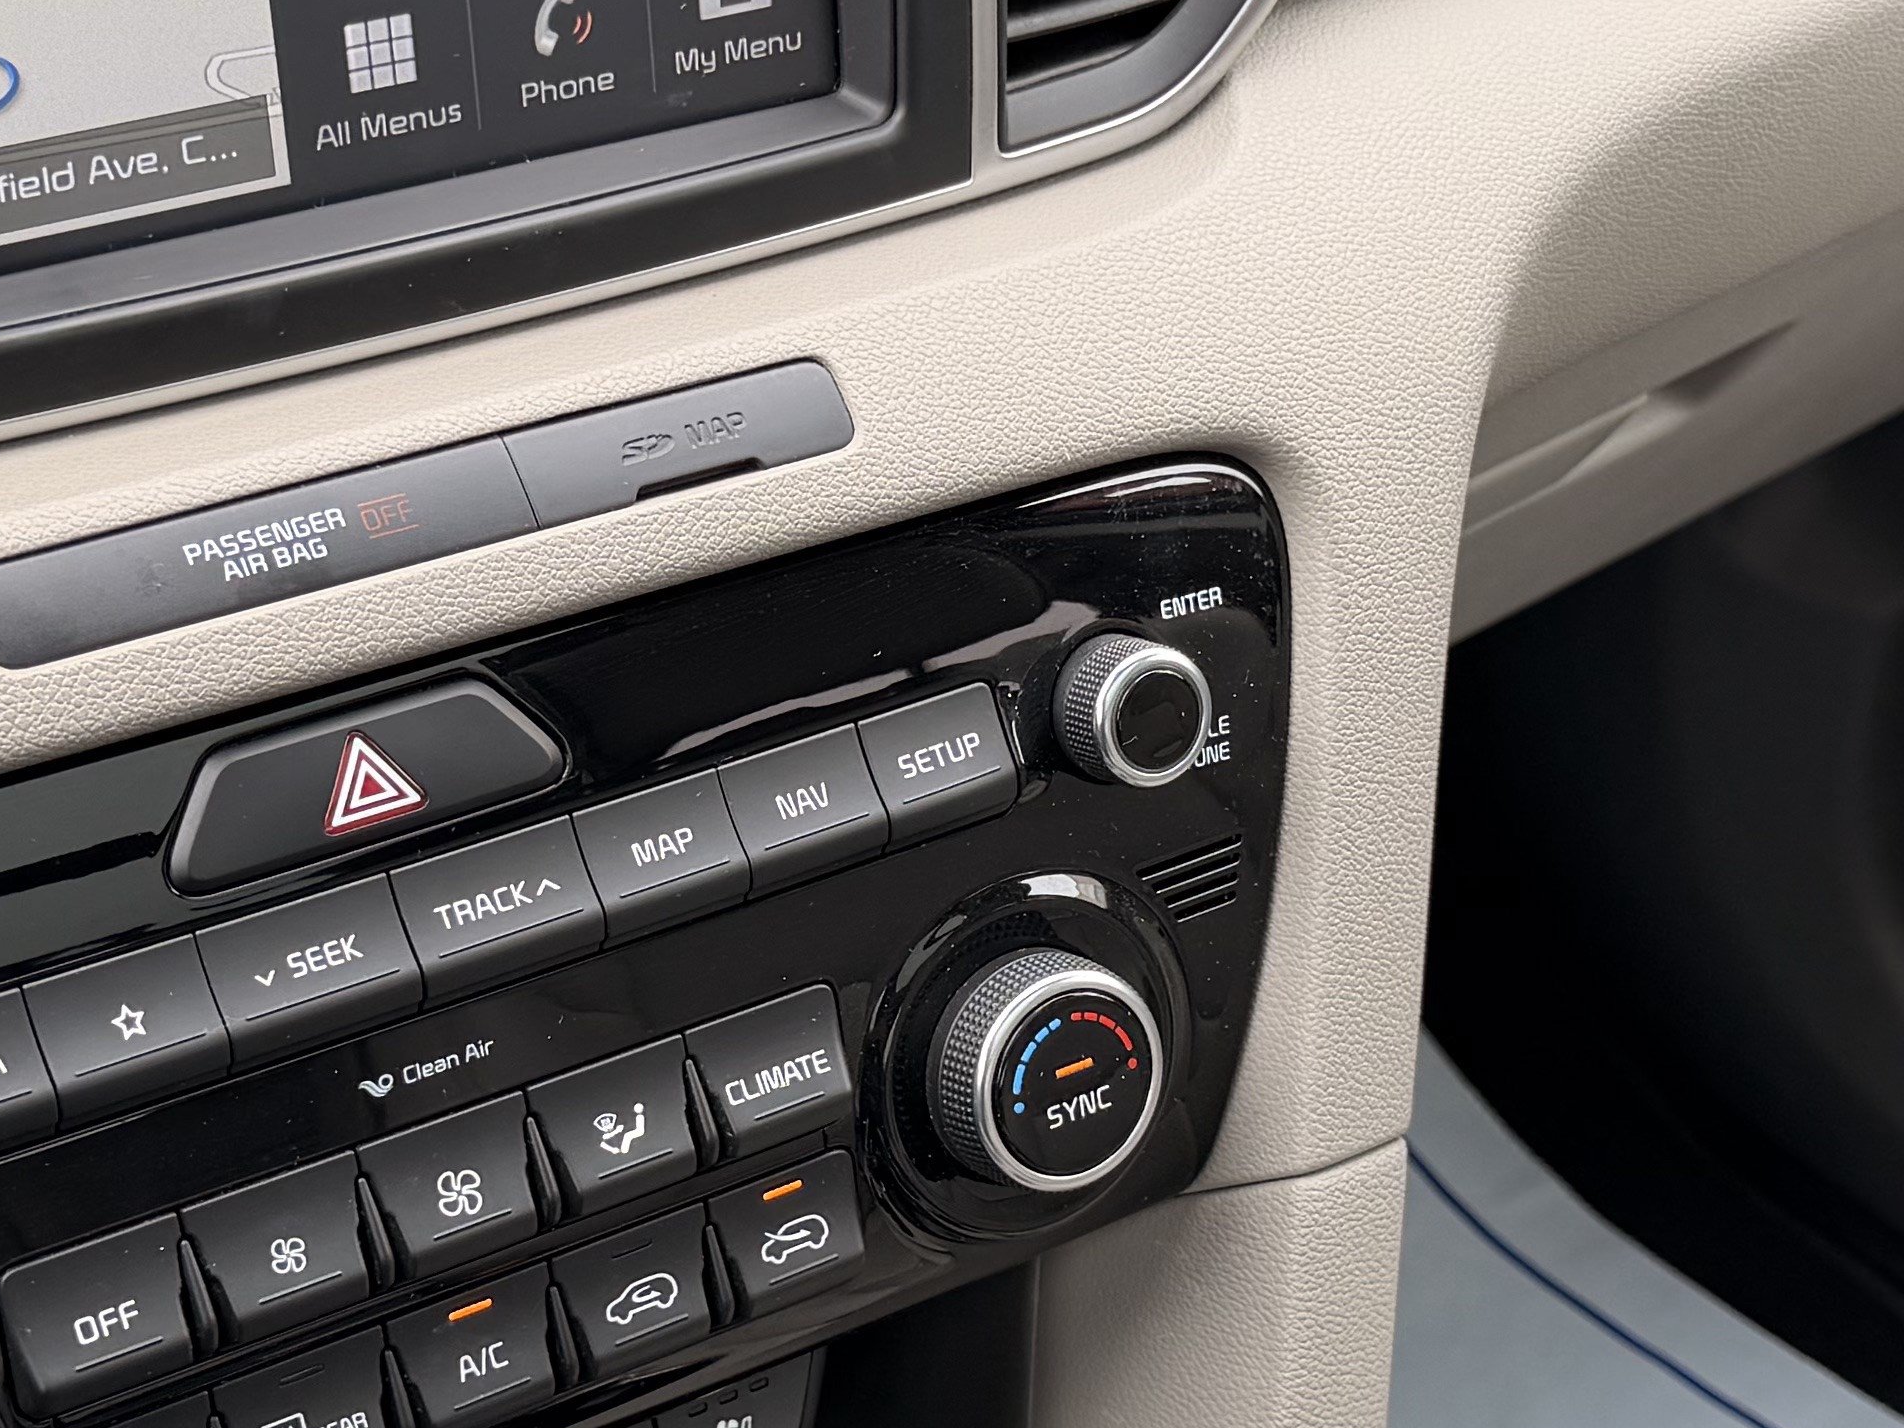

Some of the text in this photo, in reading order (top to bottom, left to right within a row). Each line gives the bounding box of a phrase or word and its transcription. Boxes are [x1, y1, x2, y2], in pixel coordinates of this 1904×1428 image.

[674, 31, 803, 76] My Menu
[520, 71, 616, 108] Phone
[316, 102, 463, 152] All Menus
[683, 410, 748, 450] MAP
[181, 507, 347, 566] PASSENGER
[359, 499, 414, 532] OFF
[222, 537, 329, 582] AIR BAG
[1160, 585, 1223, 620] ENTER
[897, 732, 981, 780] SETUP
[1194, 740, 1232, 768] UNE
[774, 781, 830, 821] NAV
[630, 826, 695, 869] MAP
[433, 883, 532, 931] TRACK
[286, 933, 364, 980] SEEK
[402, 1036, 494, 1086] Clean Air
[724, 1048, 832, 1108] CLIMATE
[1046, 1084, 1114, 1131] SYNC
[73, 1299, 141, 1346] OFF
[458, 1340, 510, 1383] A/C
